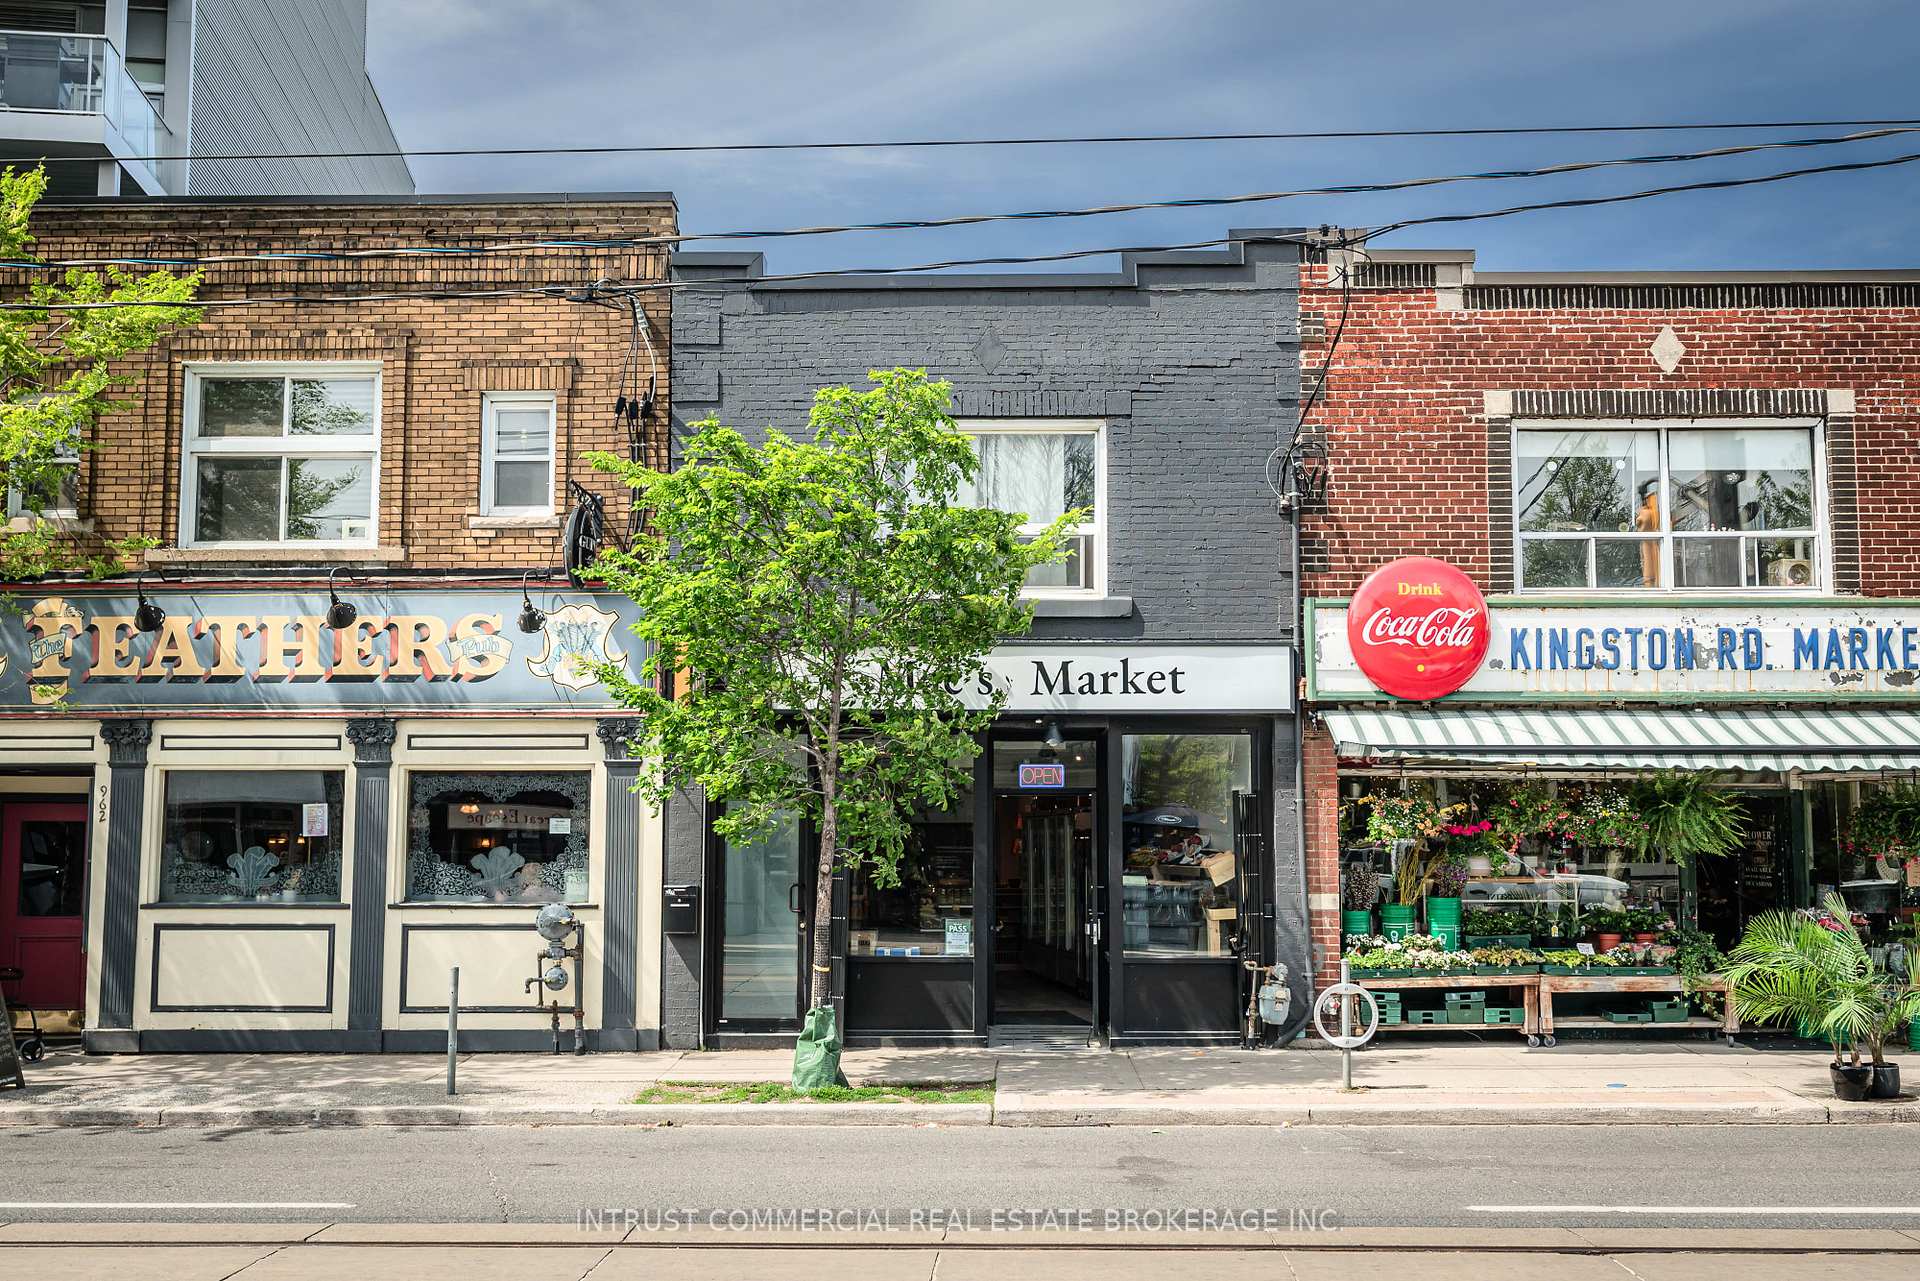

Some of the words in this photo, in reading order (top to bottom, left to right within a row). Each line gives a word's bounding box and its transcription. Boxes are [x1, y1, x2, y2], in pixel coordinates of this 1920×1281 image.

[1398, 582, 1443, 596] Drink
[1362, 607, 1480, 647] Coca-Cola
[29, 612, 508, 682] FEATHERS
[33, 637, 63, 660] The
[459, 636, 500, 657] Pub
[1510, 627, 1694, 670] KINGSTON
[1717, 627, 1772, 670] RD.
[1793, 627, 1919, 670] MARKE
[1030, 657, 1186, 696] Market
[1022, 767, 1062, 785] OPEN
[99, 784, 108, 823] 962
[948, 924, 968, 933] PASS
